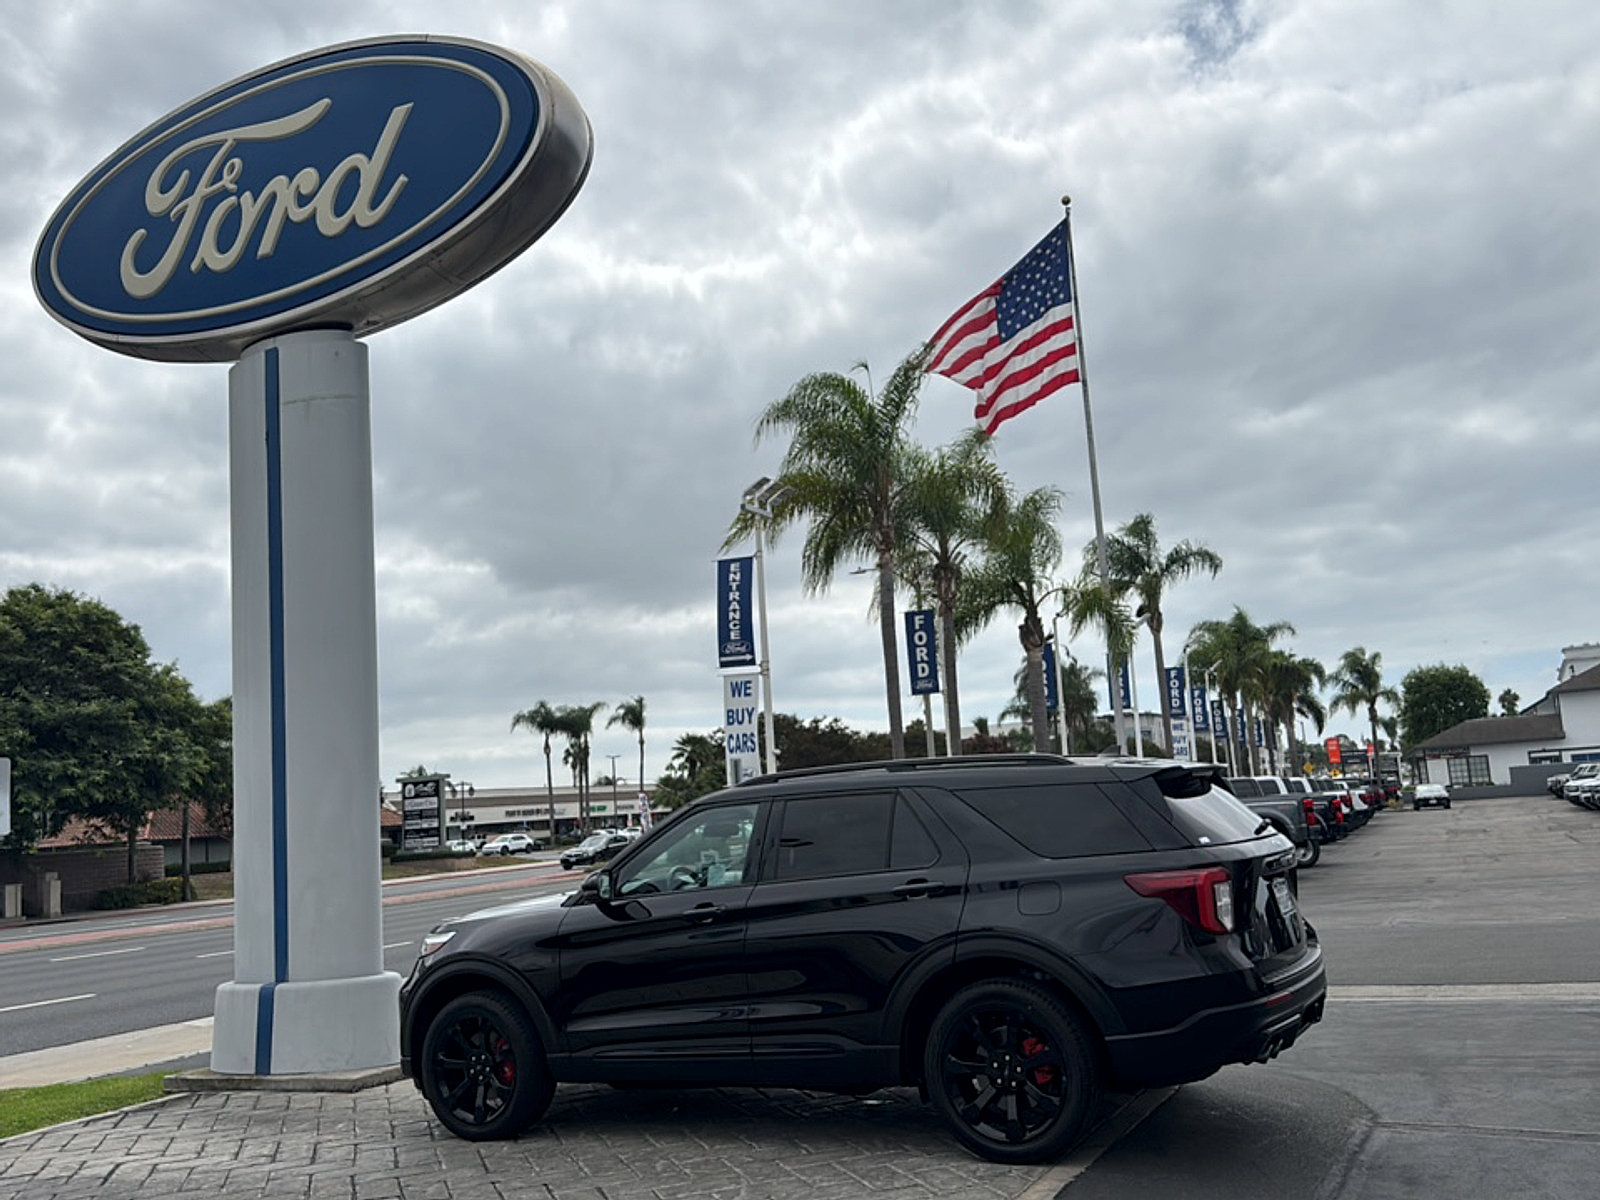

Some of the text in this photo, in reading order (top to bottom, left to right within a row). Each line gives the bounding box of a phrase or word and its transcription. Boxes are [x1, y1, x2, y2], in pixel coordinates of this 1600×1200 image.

[119, 98, 414, 299] Ford
[728, 562, 741, 640] ENTRANCE
[913, 615, 930, 678] FORD
[730, 680, 752, 698] WE
[1169, 670, 1180, 707] FORD
[1193, 689, 1203, 723] FORD
[726, 707, 755, 726] BUY
[728, 733, 756, 754] CARS
